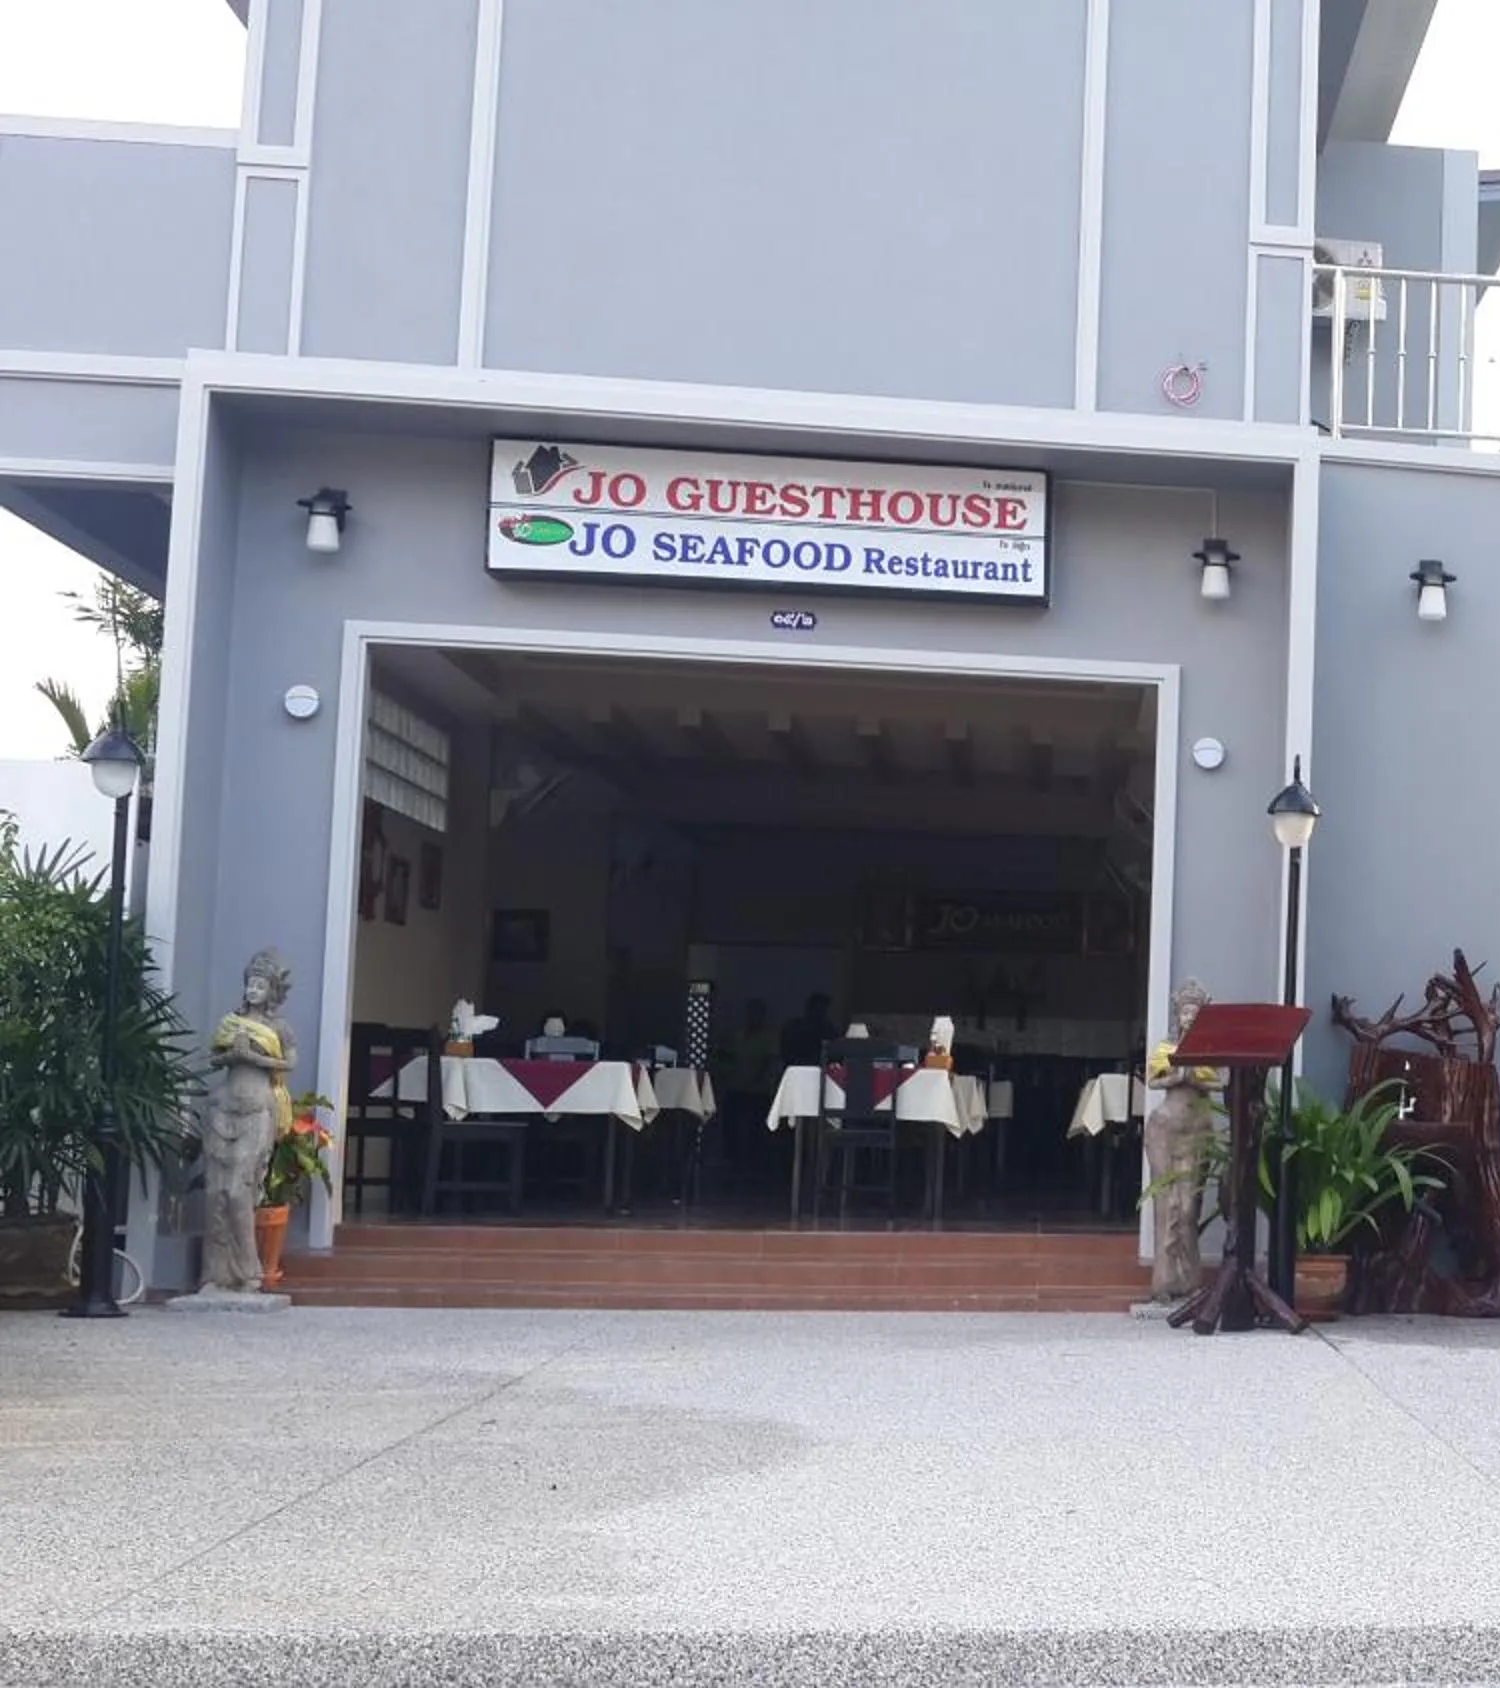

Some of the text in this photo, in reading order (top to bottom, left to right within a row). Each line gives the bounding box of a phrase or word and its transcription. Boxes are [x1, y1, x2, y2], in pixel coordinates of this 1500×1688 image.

[573, 471, 1028, 530] JO GUESTHOUSE
[569, 522, 636, 559] JO
[652, 532, 852, 572] SEAFOOD
[863, 547, 1032, 583] Restaurant
